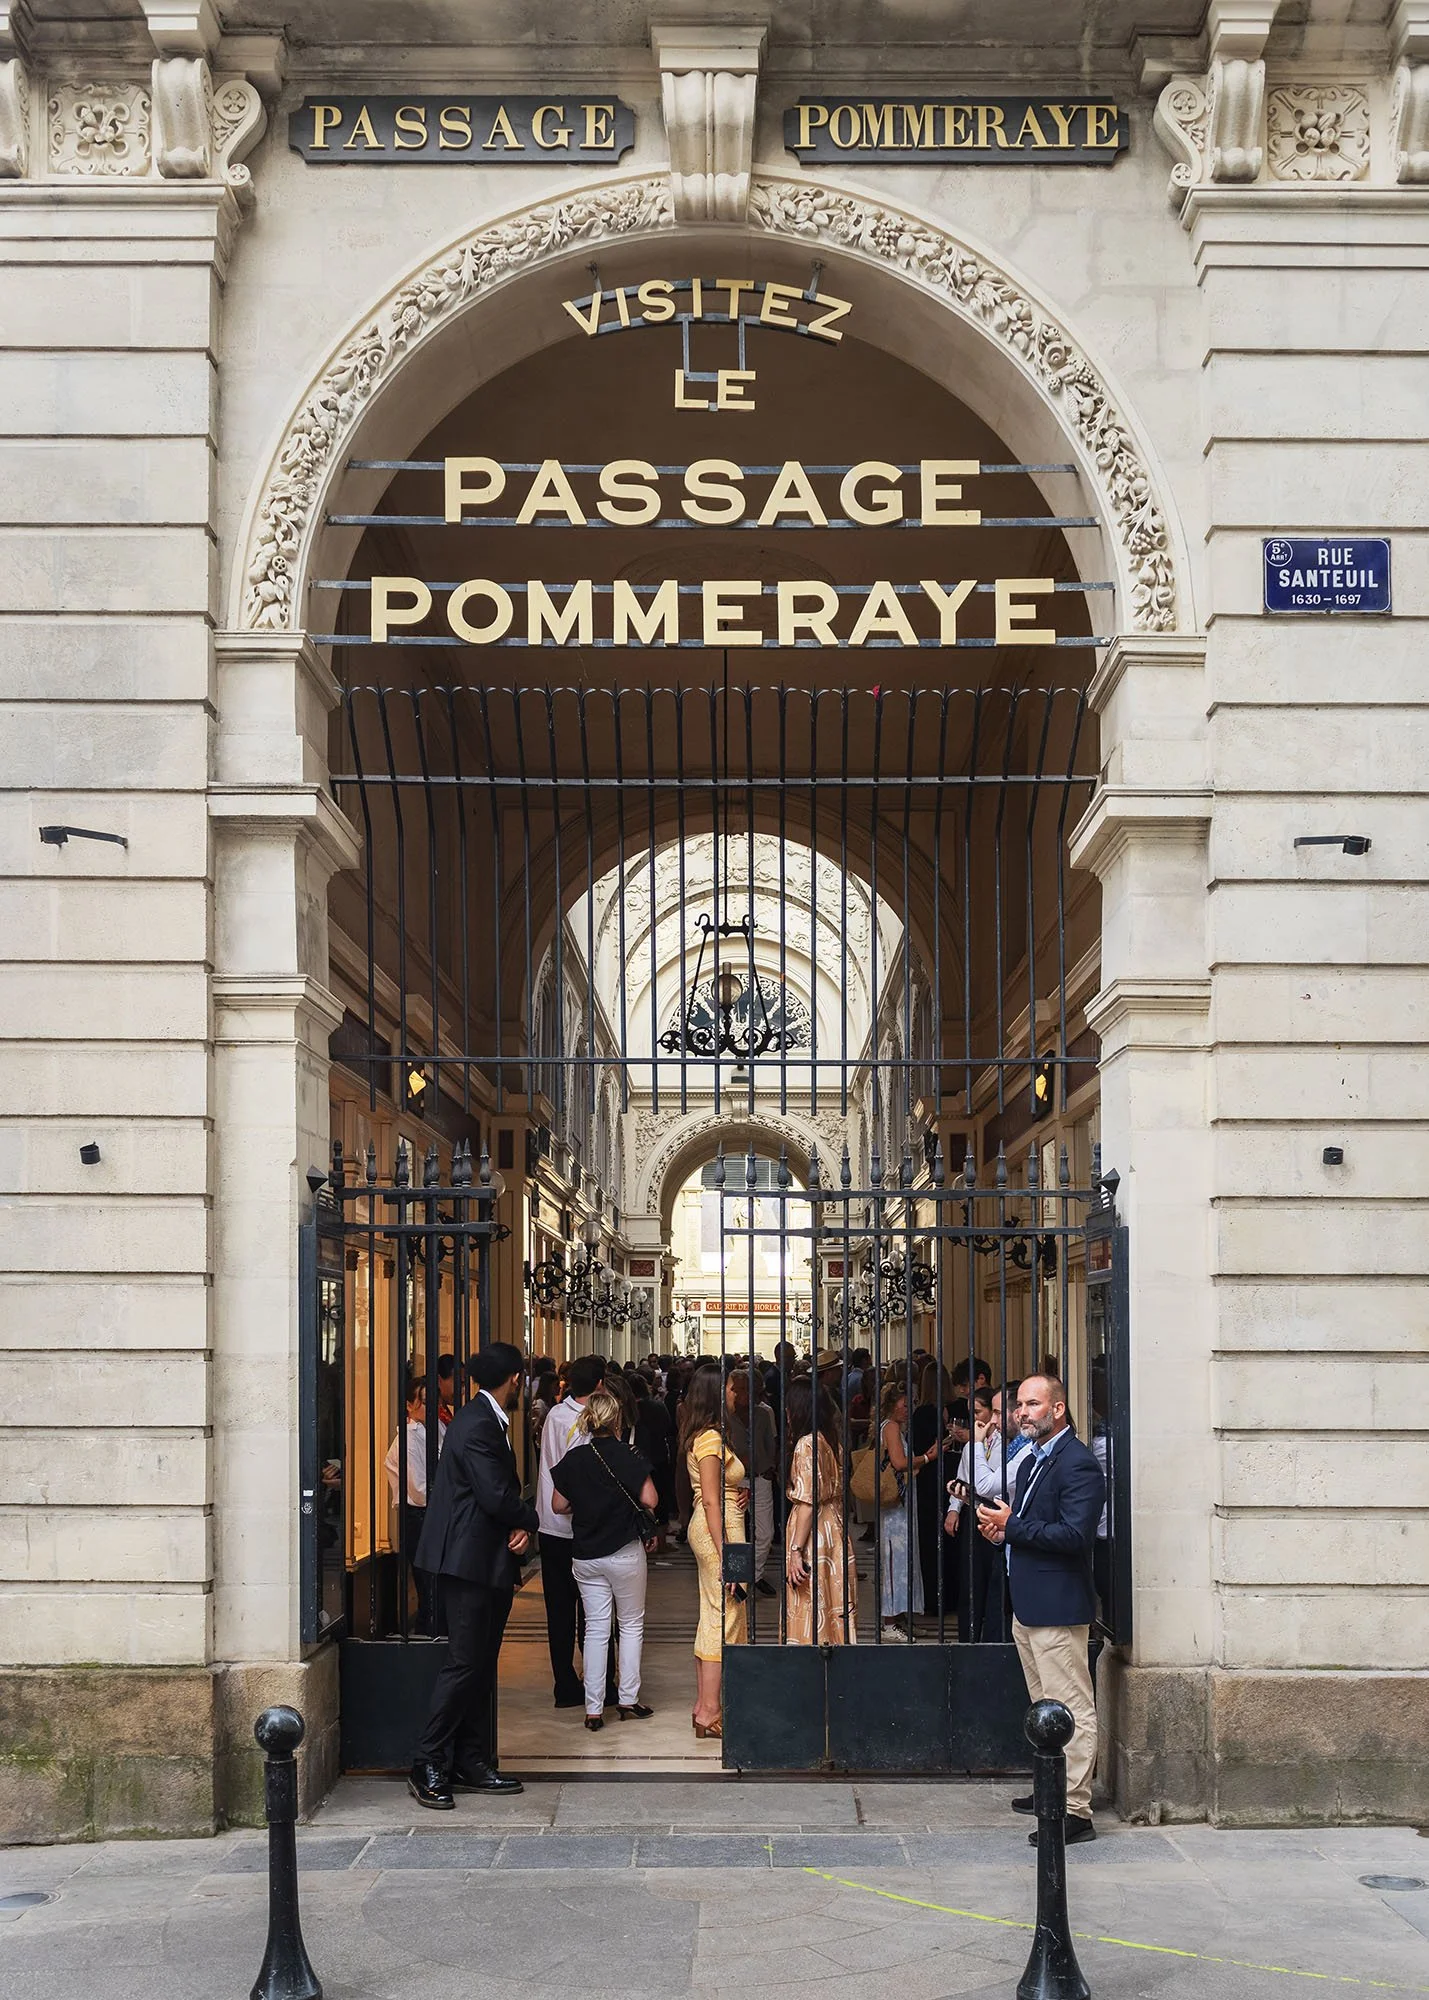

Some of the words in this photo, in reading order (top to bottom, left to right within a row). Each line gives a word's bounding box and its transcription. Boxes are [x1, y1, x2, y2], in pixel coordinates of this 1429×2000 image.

[312, 104, 616, 149] PASSAGE
[797, 103, 1121, 149] POMMERAYE
[562, 278, 854, 343] VISITEZ
[674, 369, 757, 411] LE
[444, 456, 982, 527] PASSAGE
[1278, 569, 1379, 588] SANTEUIL
[1317, 547, 1354, 566] RUE
[370, 576, 1057, 647] POMMERAYE
[706, 1303, 737, 1311] GALRIE
